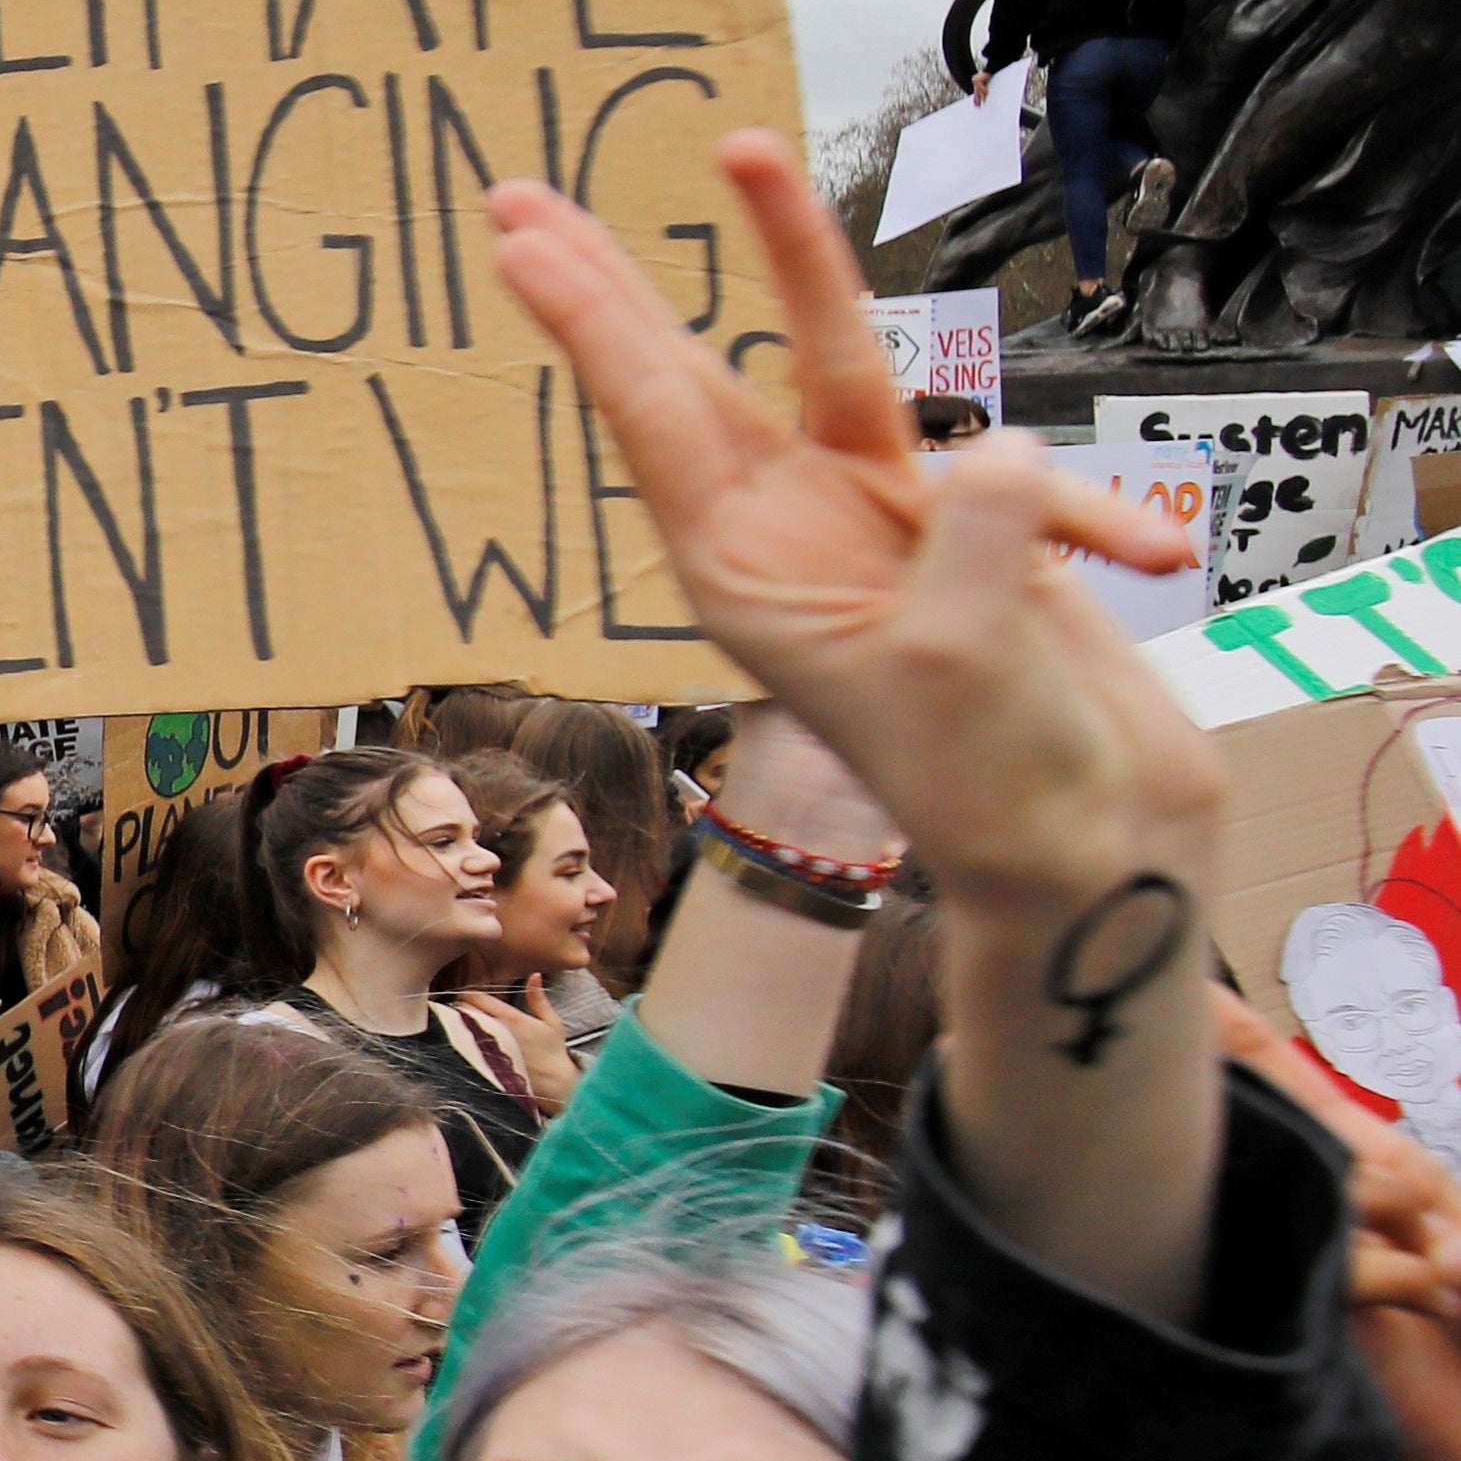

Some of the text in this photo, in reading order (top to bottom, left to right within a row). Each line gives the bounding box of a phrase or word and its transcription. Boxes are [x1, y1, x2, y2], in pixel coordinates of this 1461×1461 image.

[931, 324, 994, 359] VELS
[929, 360, 998, 396] ISING
[1139, 410, 1369, 461] Sstem
[1390, 405, 1461, 452] MAK
